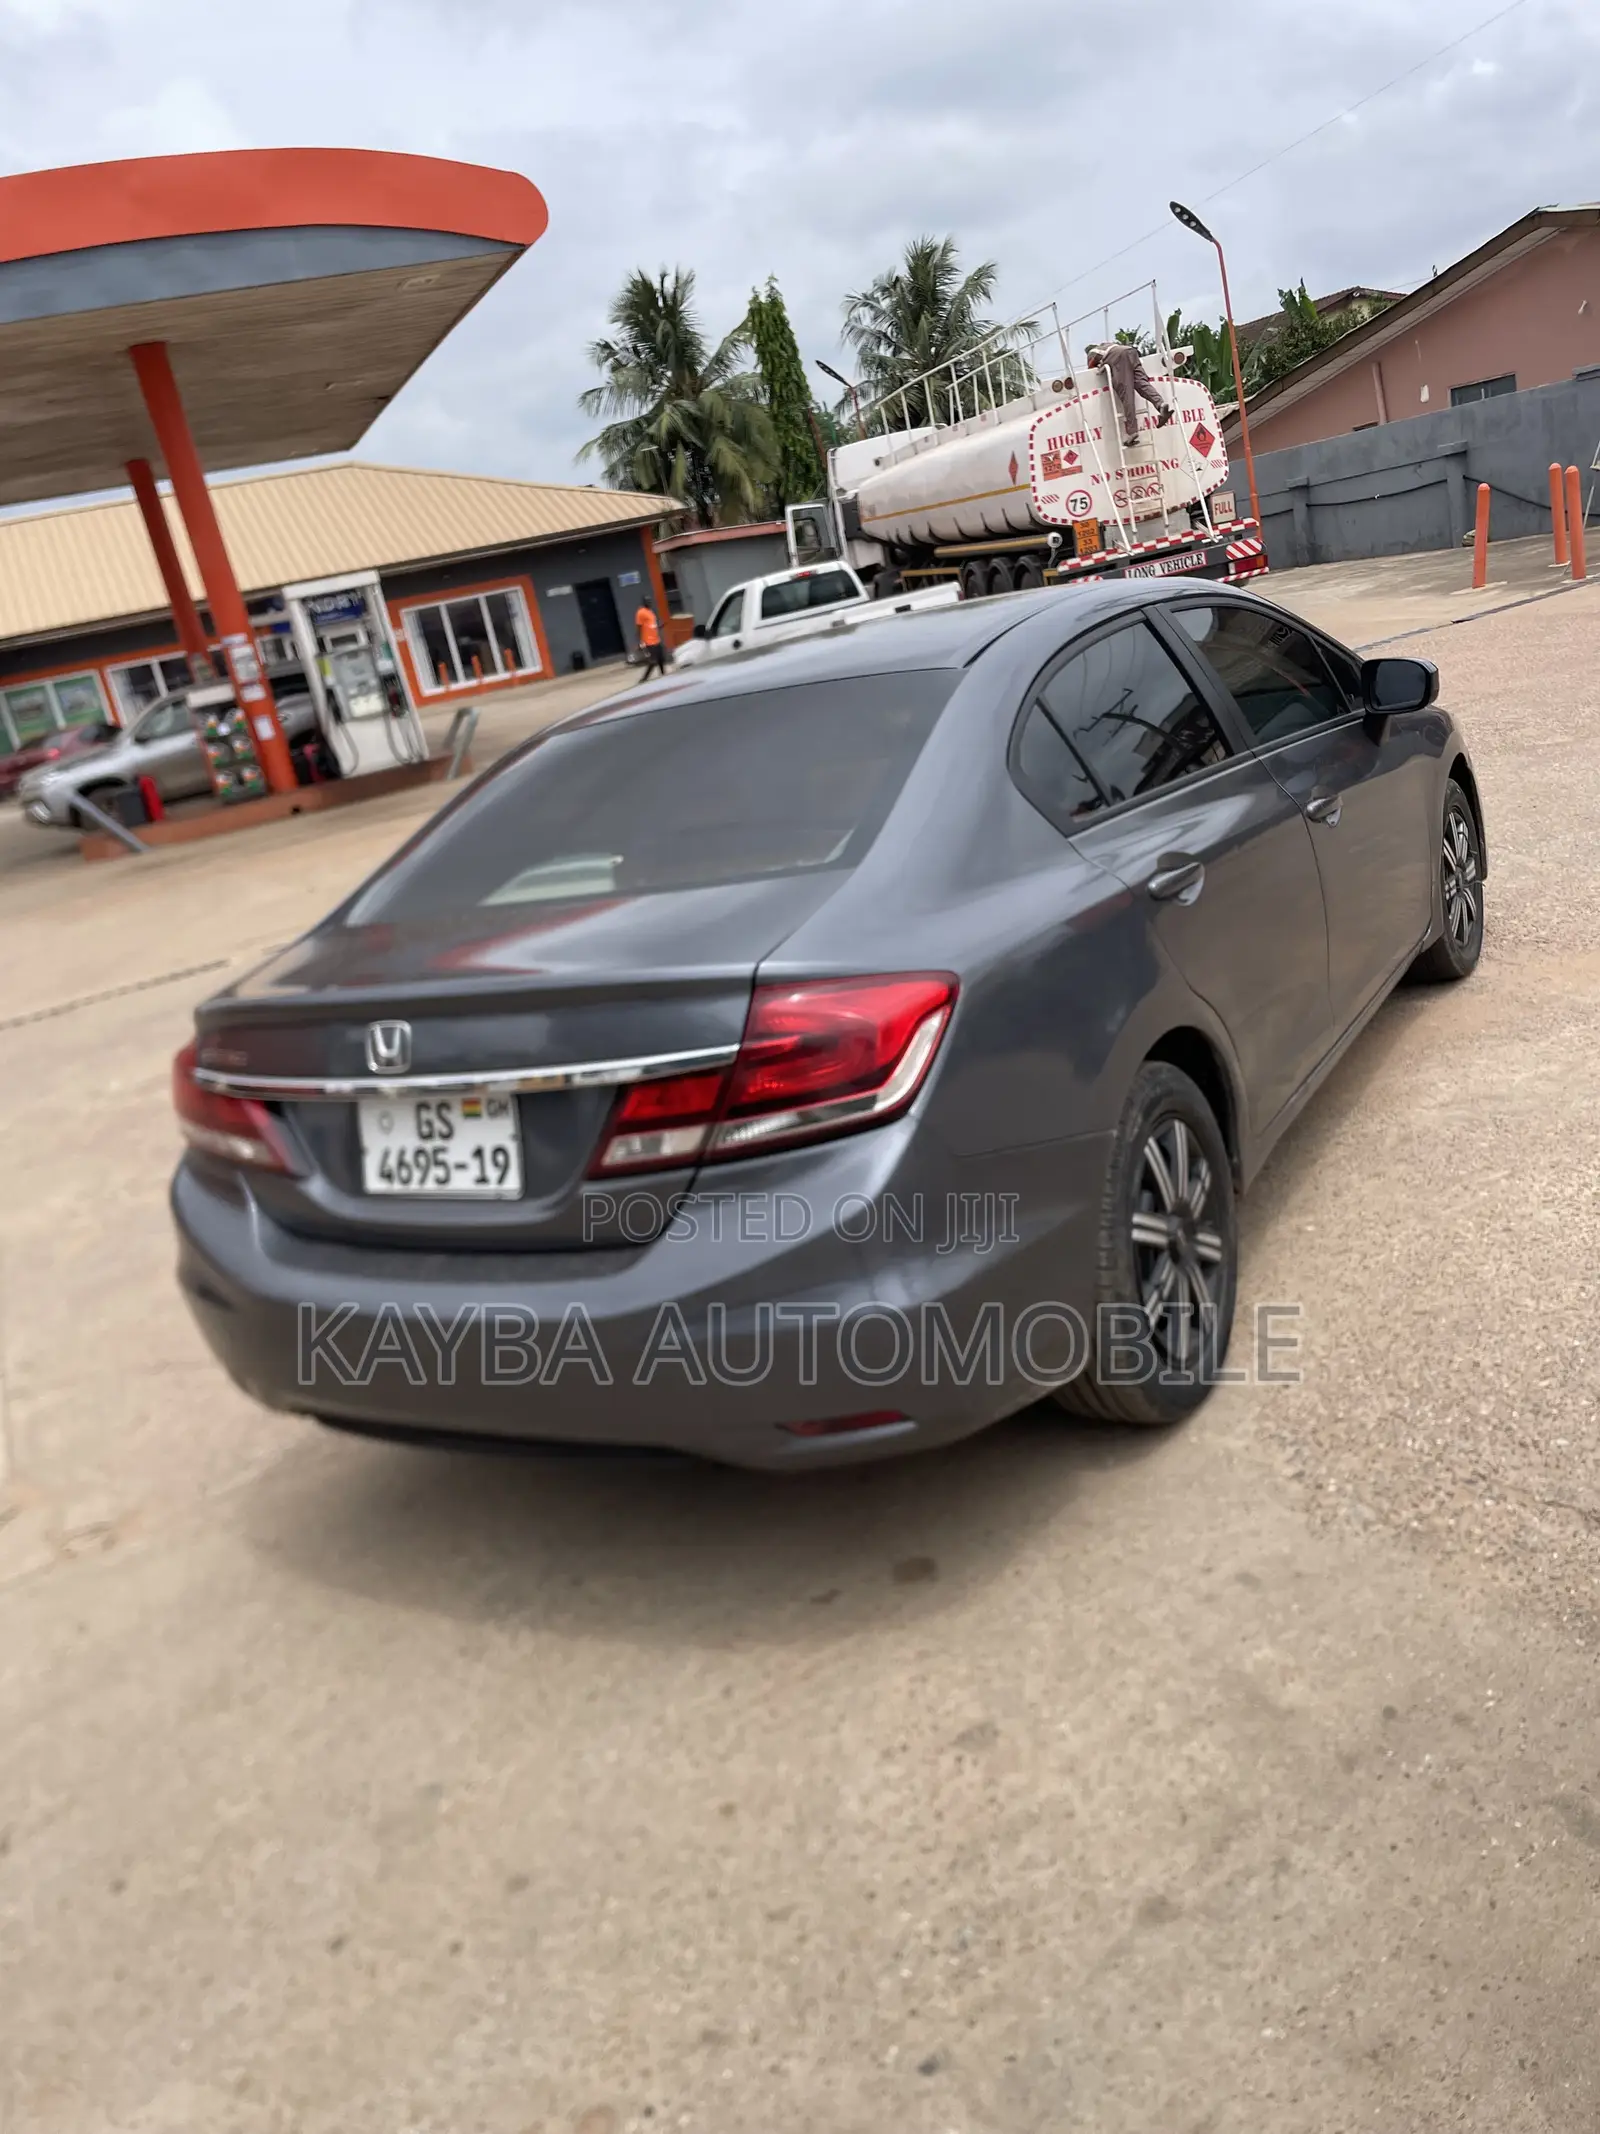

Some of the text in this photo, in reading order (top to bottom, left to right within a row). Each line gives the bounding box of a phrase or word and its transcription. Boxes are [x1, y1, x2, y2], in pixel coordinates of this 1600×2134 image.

[1069, 497, 1088, 512] 75
[1214, 501, 1232, 516] FULL
[1127, 553, 1203, 578] LONG VEHICLE
[415, 1101, 454, 1140] GS
[379, 1145, 510, 1185] 4695-19
